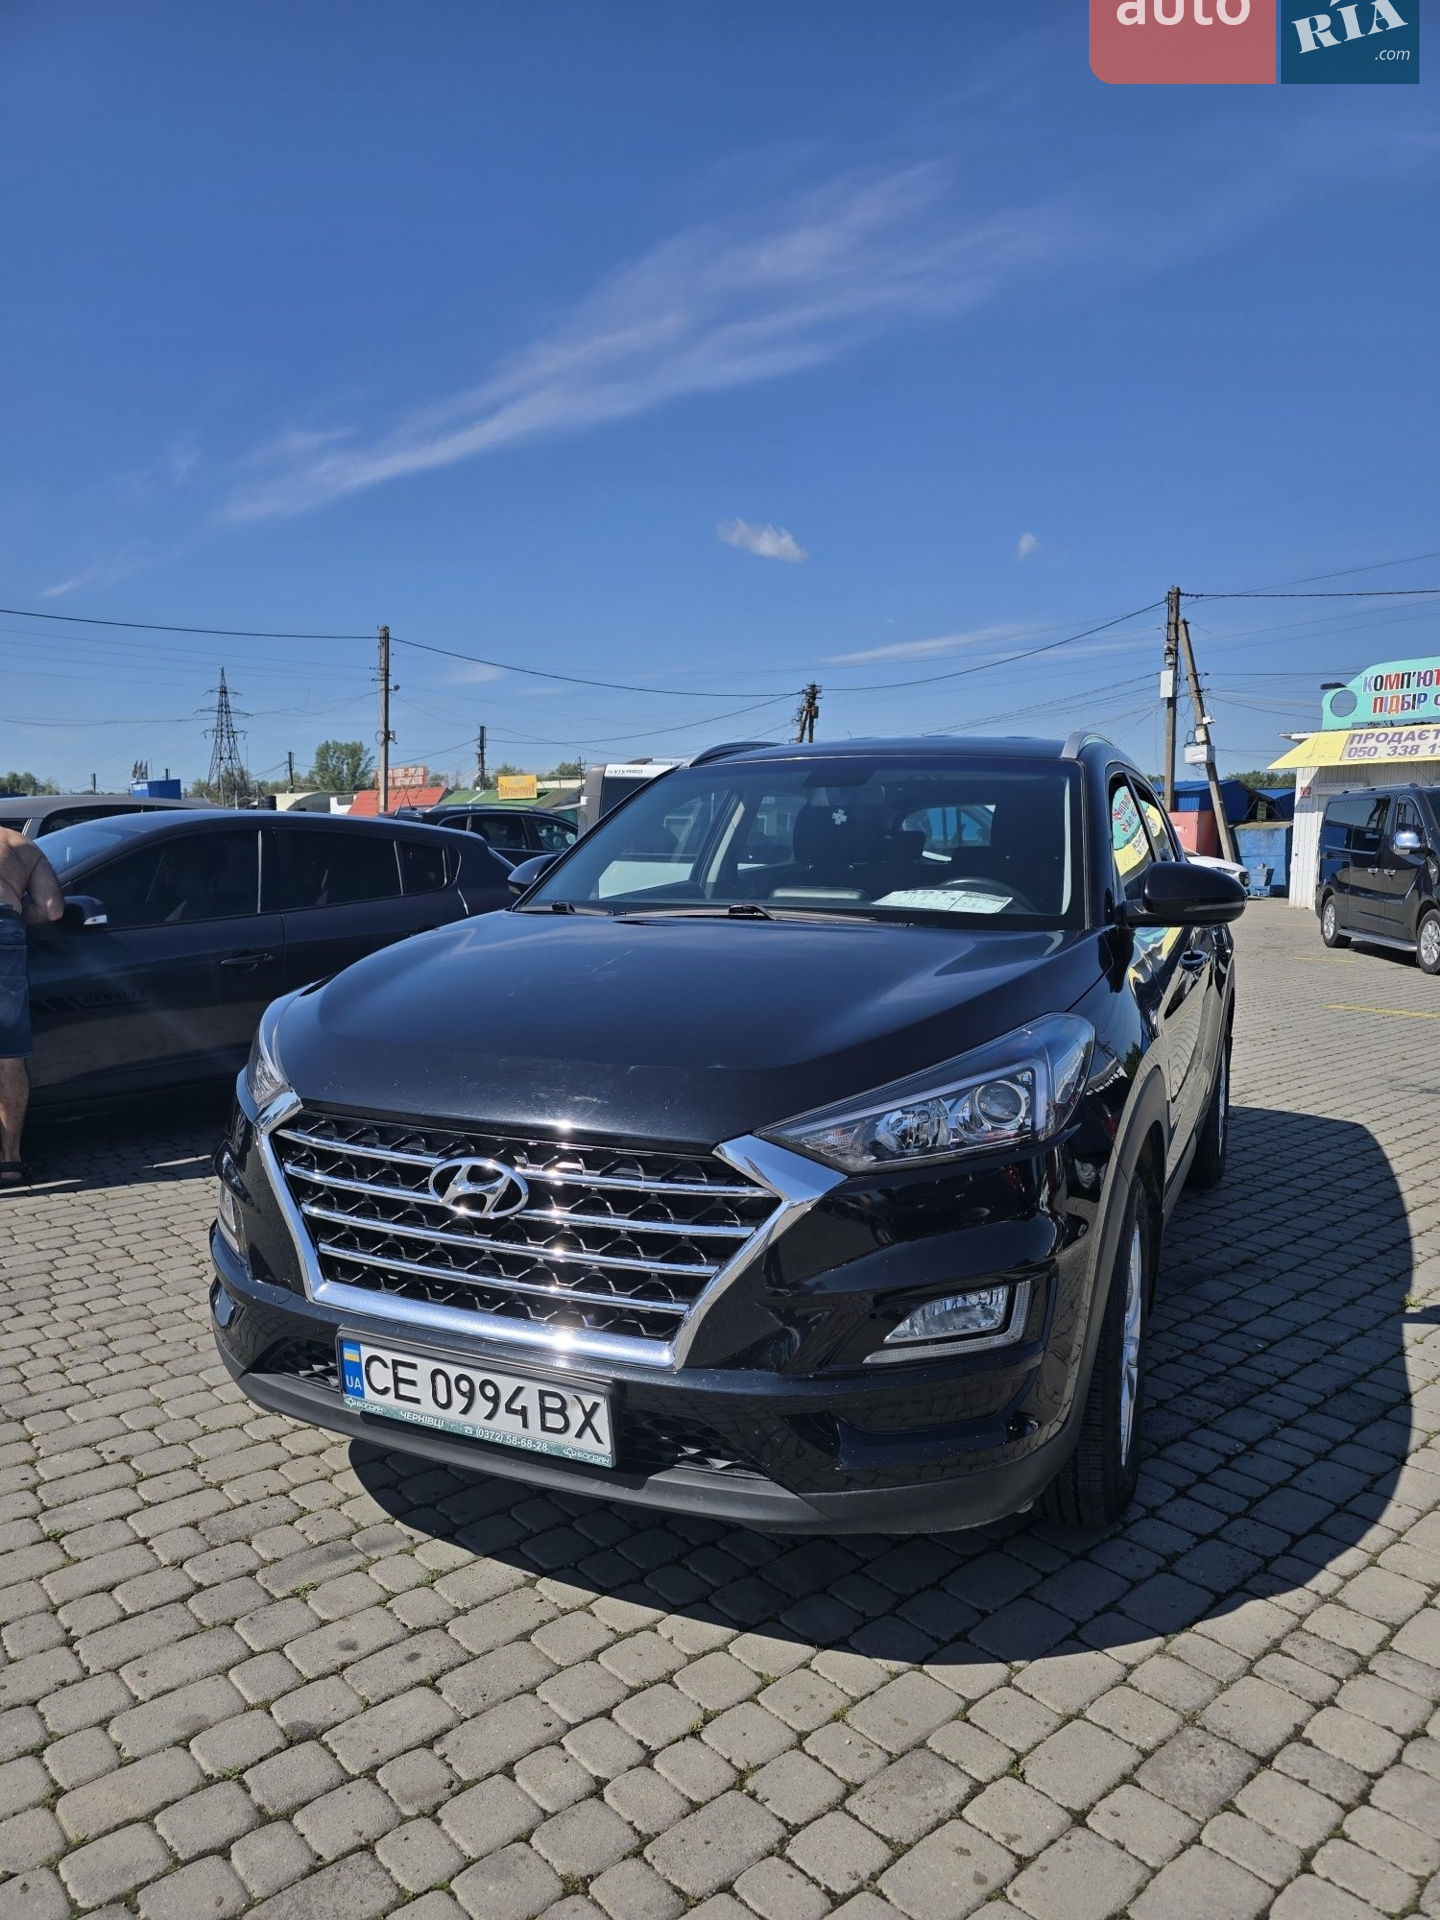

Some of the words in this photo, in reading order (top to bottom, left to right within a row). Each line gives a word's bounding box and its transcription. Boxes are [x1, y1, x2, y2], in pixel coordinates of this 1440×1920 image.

[1372, 692, 1428, 714] ПІДБІР
[1347, 746, 1378, 758] 050
[1386, 744, 1420, 757] 338
[345, 1374, 362, 1391] UA
[364, 1354, 422, 1405] CE
[430, 1367, 530, 1429] 0994
[538, 1389, 604, 1444] BX
[400, 1410, 444, 1428] ЧЕРНІВЦІ
[475, 1425, 503, 1443] (0372)
[506, 1435, 548, 1451] 58-68-28
